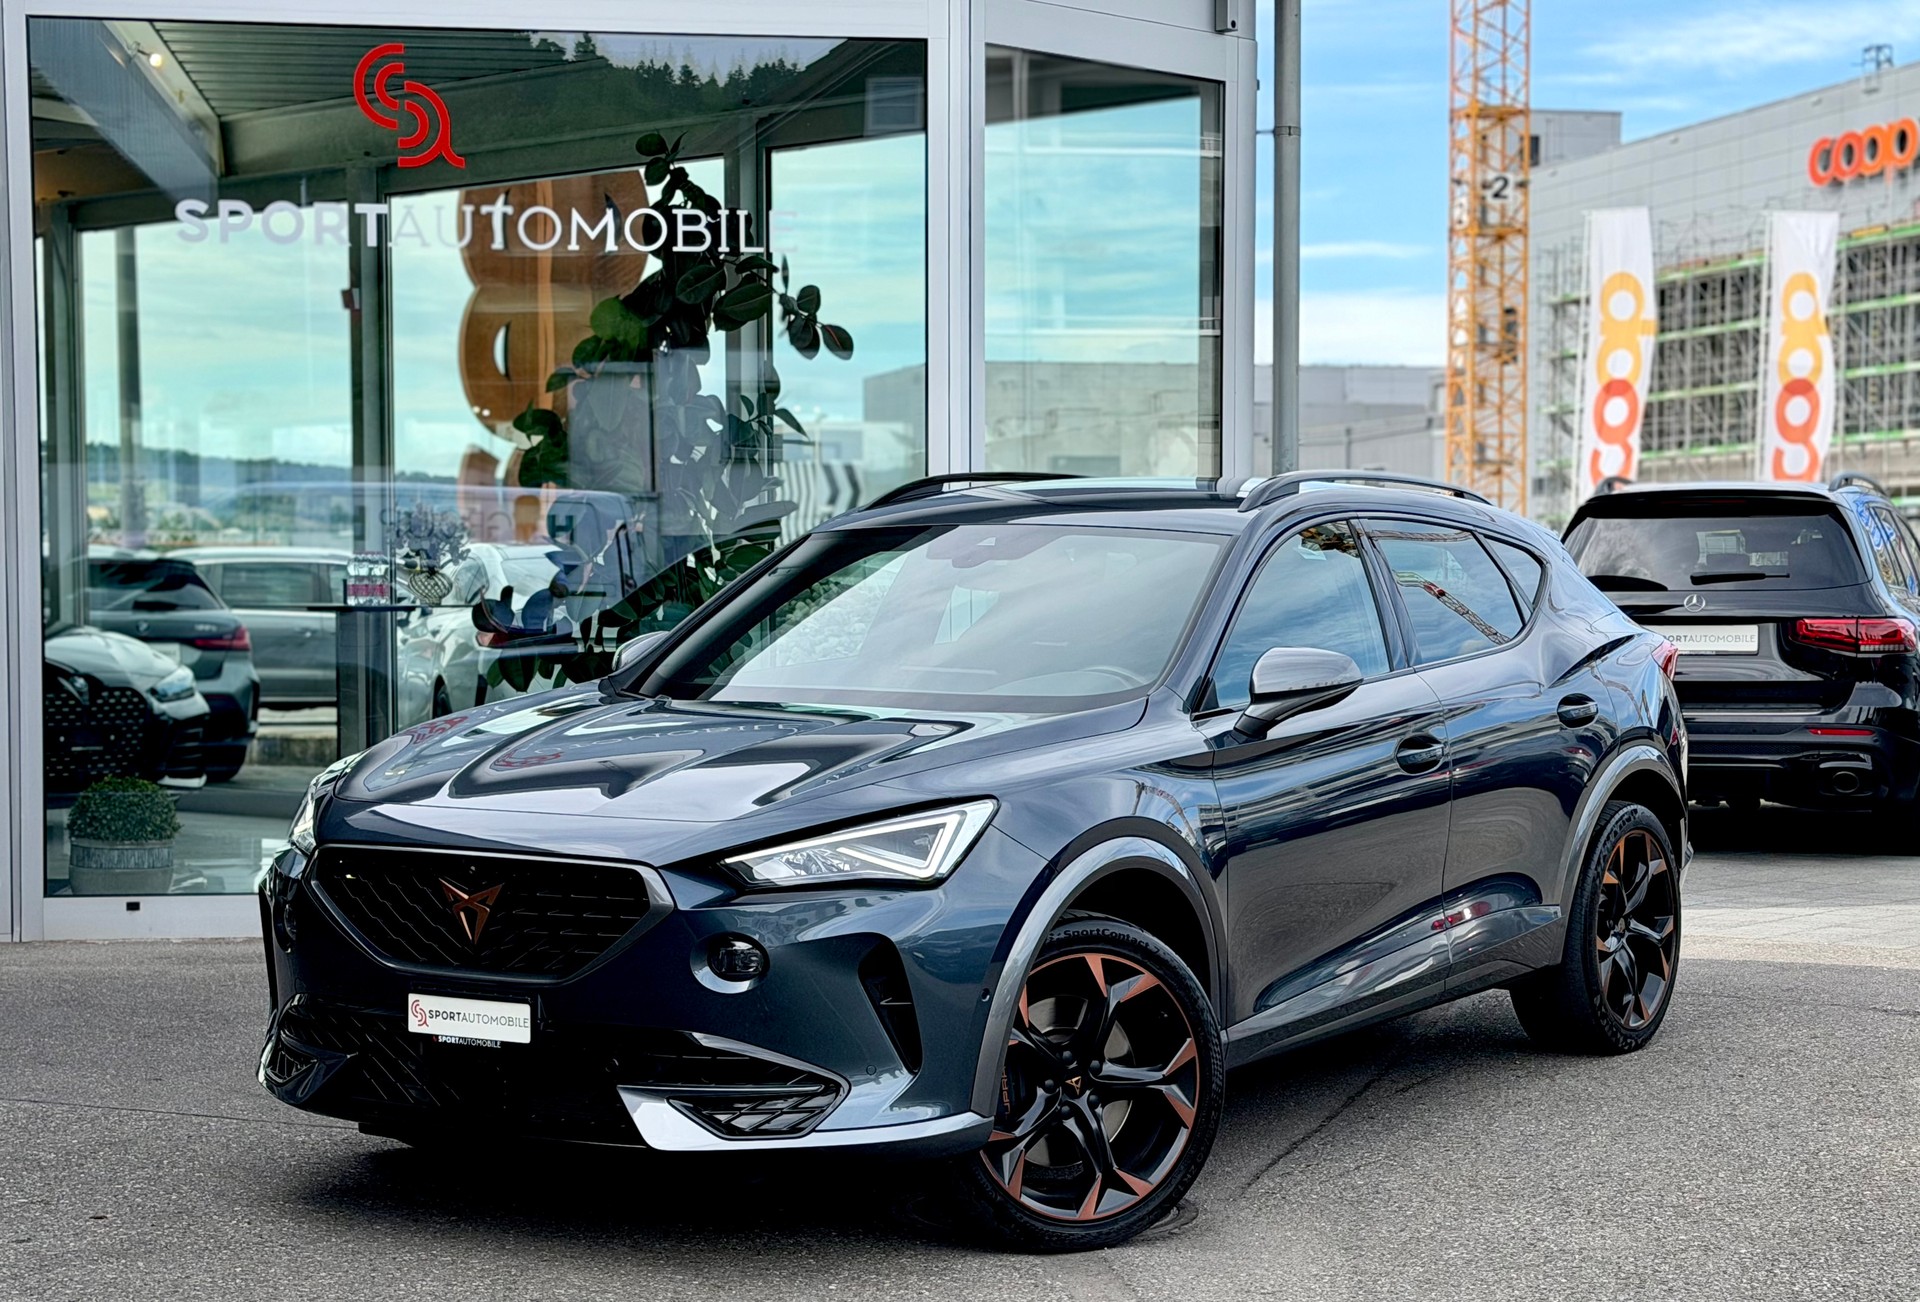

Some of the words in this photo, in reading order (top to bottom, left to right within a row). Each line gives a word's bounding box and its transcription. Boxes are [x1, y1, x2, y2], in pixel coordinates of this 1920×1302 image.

[1808, 117, 1918, 188] coop
[1492, 175, 1509, 199] 2
[174, 199, 798, 253] SPORTAUTOMOBILE
[1063, 927, 1150, 949] SportContact
[428, 1009, 529, 1028] SPORTAUTOMOBILE
[438, 1035, 502, 1048] SPORTAUTOMOBILE
